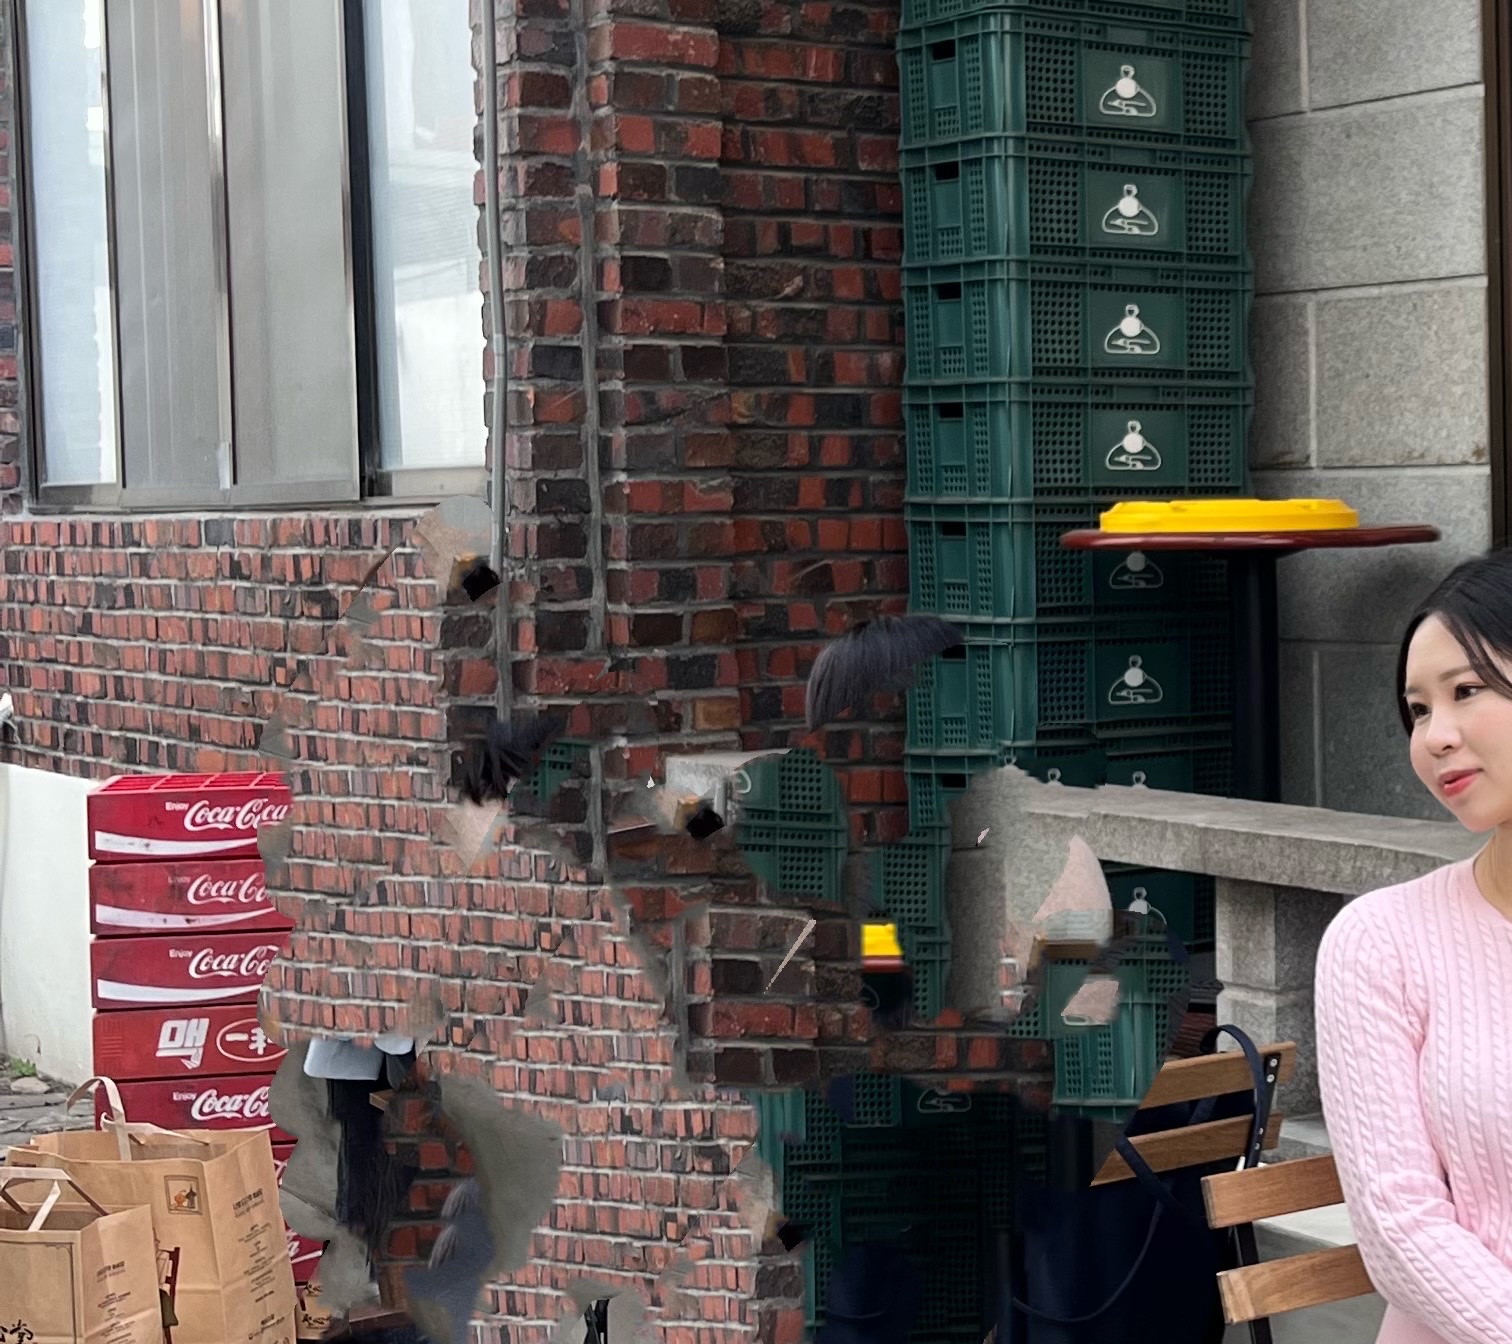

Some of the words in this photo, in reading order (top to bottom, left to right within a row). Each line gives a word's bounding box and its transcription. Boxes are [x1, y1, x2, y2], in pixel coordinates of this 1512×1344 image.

[187, 873, 267, 904] Coca-Co
[189, 944, 279, 978] Coca-Co
[191, 1086, 271, 1121] Coca-Co
